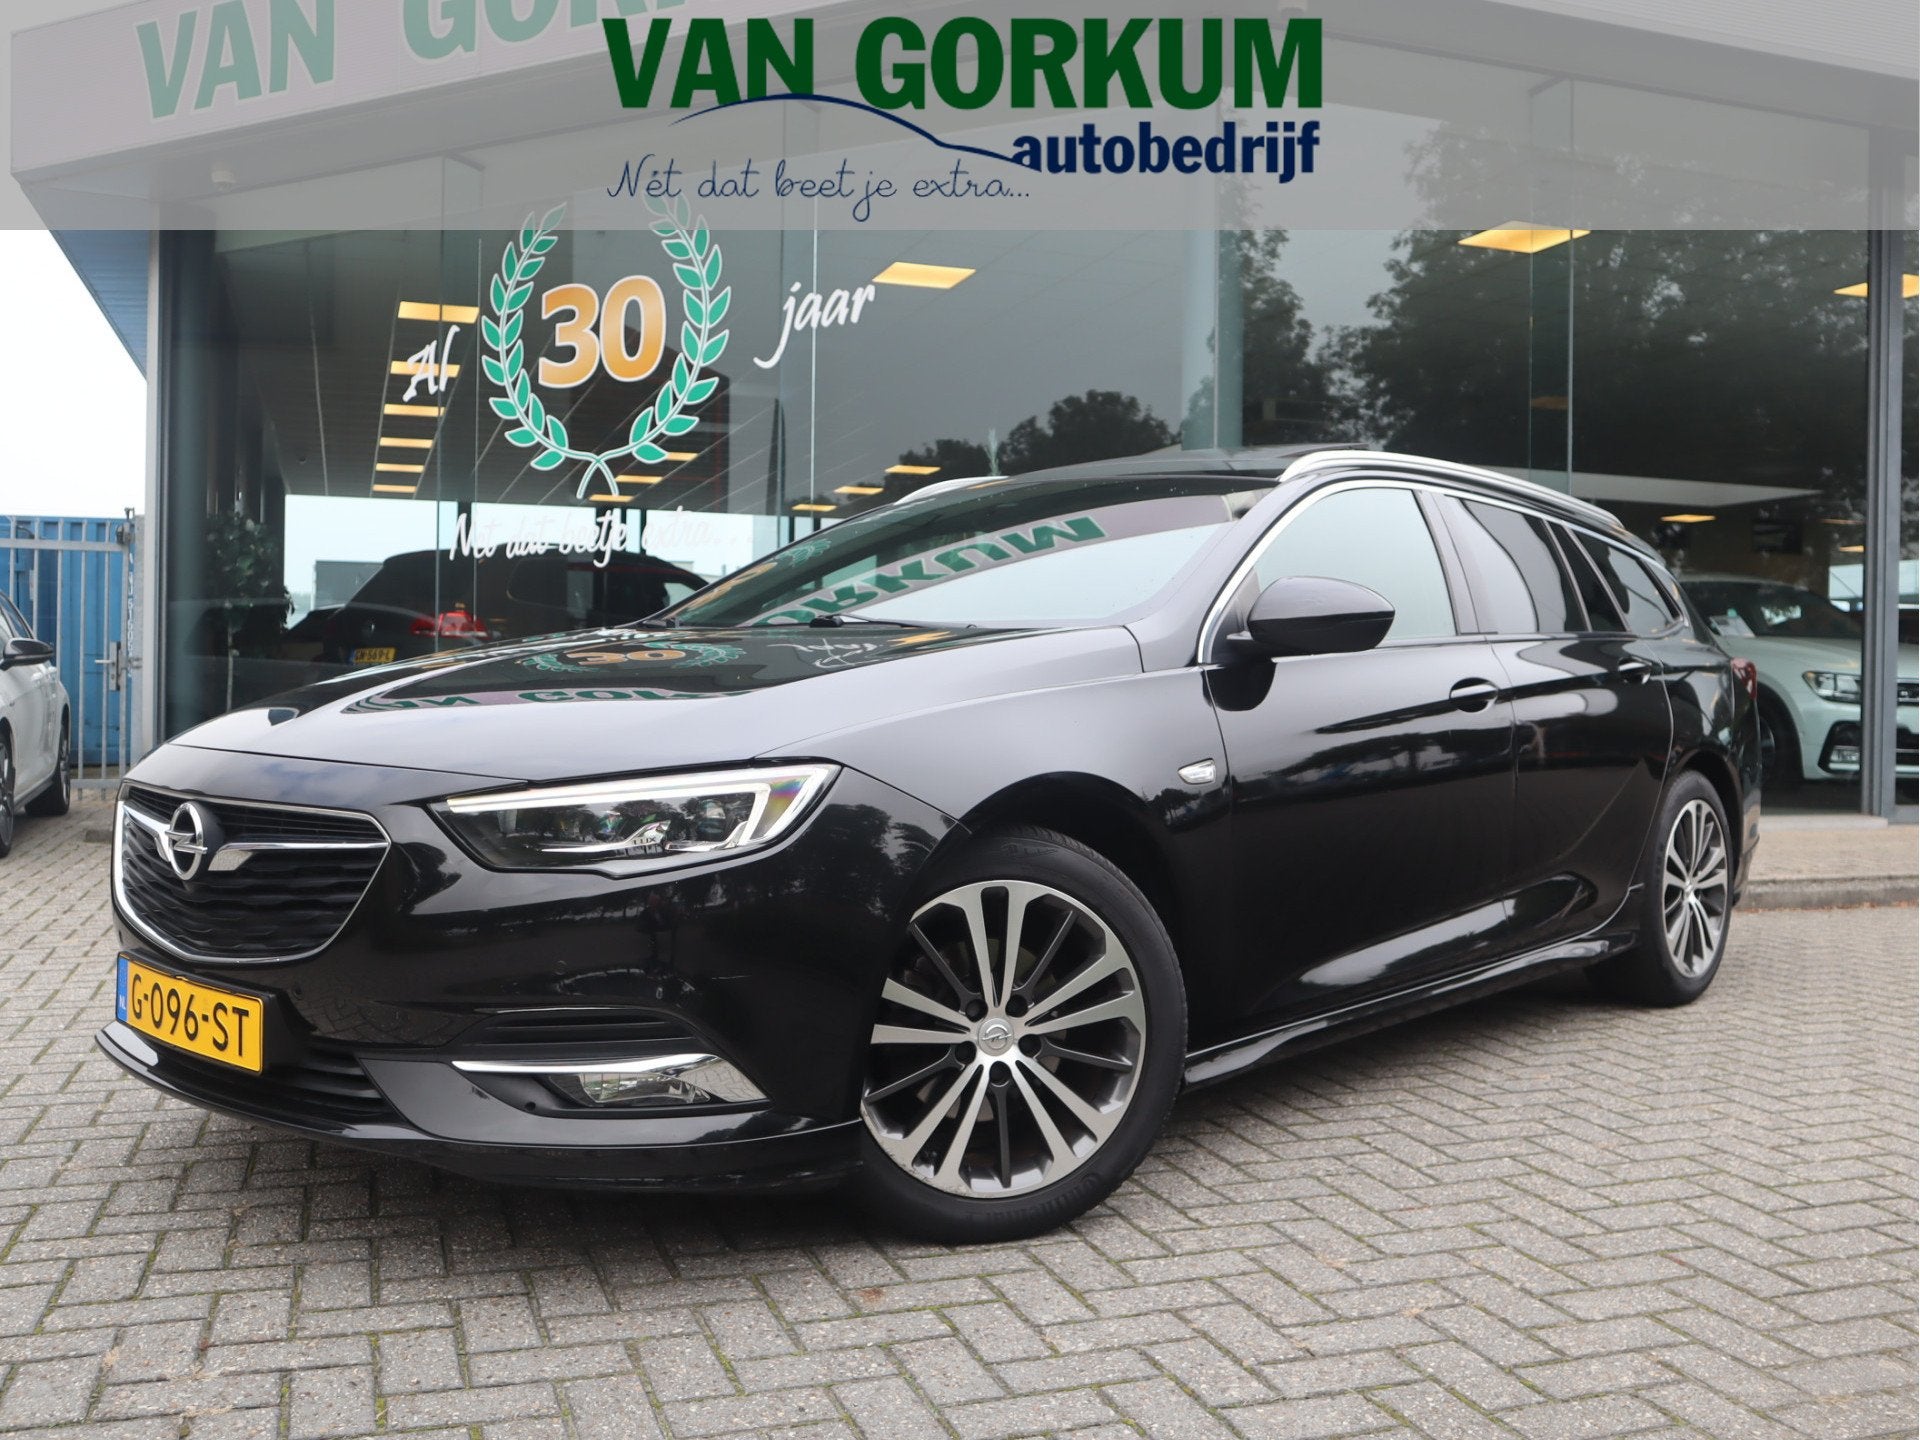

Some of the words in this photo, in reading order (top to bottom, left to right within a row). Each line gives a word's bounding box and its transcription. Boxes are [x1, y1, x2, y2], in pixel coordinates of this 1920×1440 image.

[136, 0, 335, 119] VAN
[402, 325, 460, 402] Al
[537, 274, 667, 389] 30
[752, 281, 876, 369] jaar
[557, 507, 628, 569] beetje
[130, 972, 250, 1058] G-096-ST
